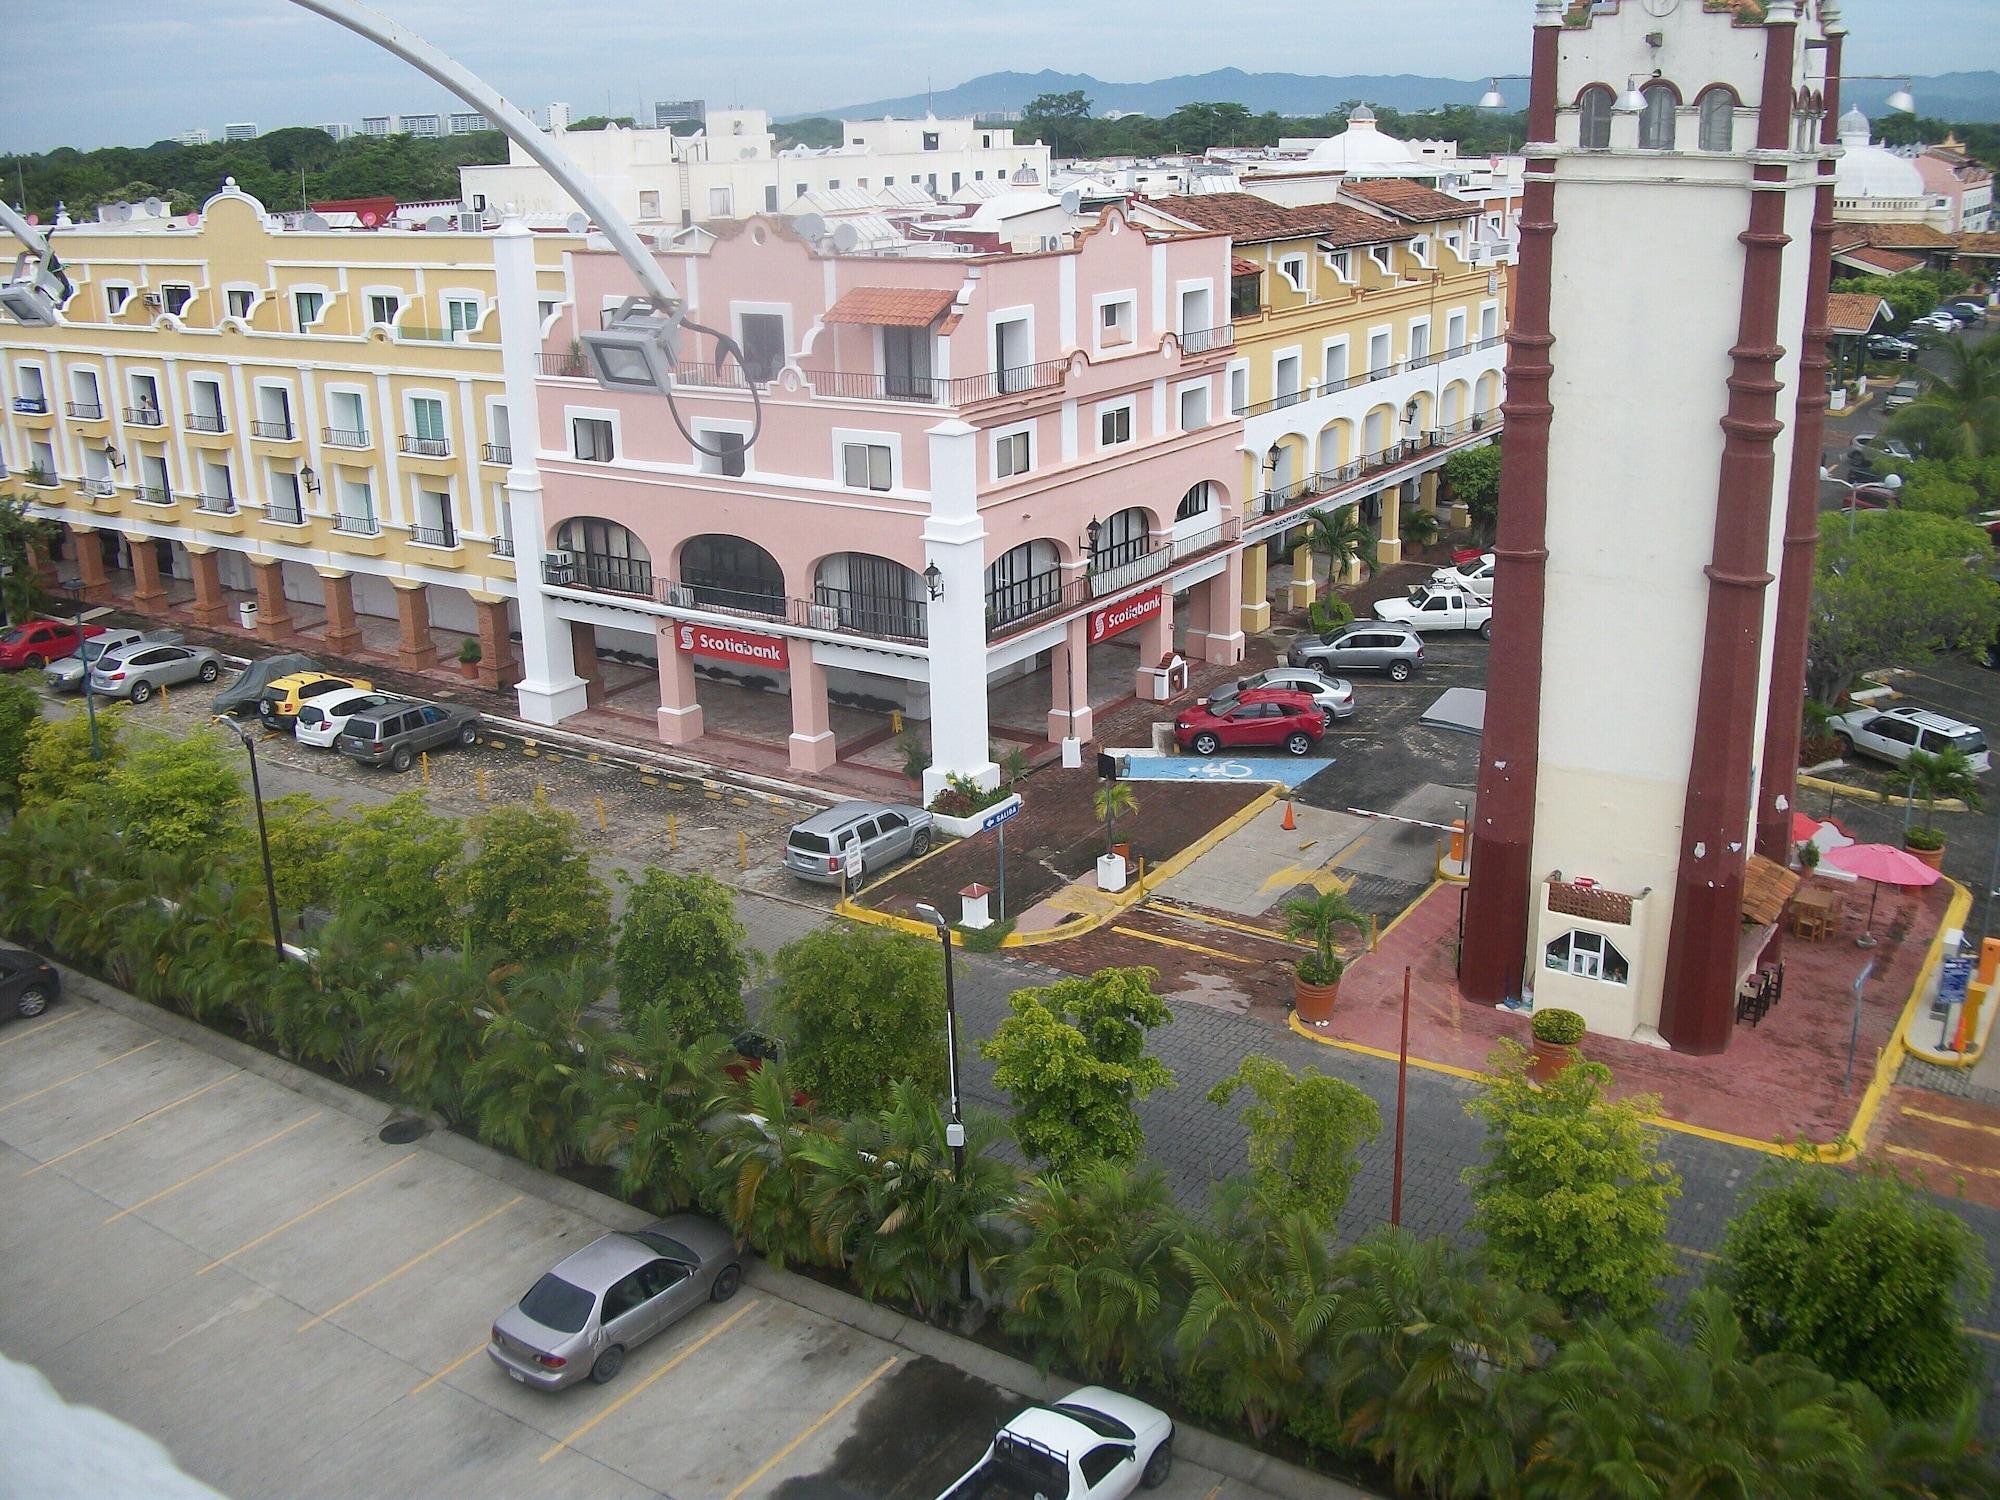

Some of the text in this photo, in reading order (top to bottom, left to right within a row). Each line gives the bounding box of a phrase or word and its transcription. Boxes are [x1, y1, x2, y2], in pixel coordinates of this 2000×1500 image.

[1108, 594, 1161, 629] Scotiabank
[699, 633, 781, 661] Scotiabank
[996, 806, 1017, 823] SALIDA
